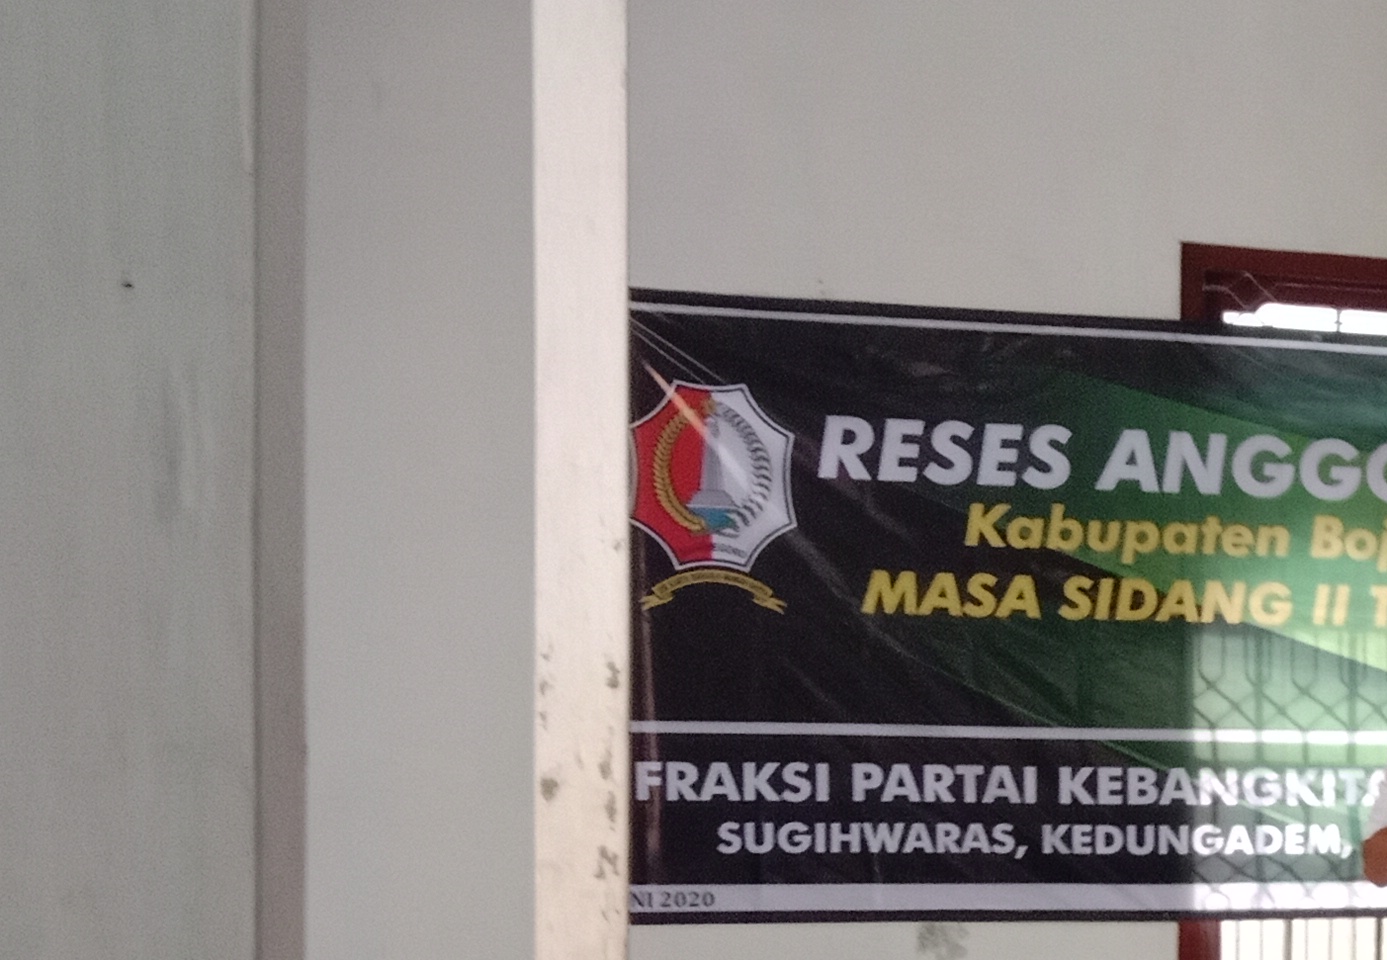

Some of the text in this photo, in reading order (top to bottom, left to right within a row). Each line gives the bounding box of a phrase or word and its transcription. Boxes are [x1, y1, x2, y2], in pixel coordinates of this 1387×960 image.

[817, 415, 1072, 488] RESES
[964, 503, 1289, 562] Kabupaten
[862, 571, 1040, 619] MASA
[1058, 576, 1292, 625] SIDANG
[1313, 584, 1350, 627] II
[636, 761, 1386, 807] FRAKSI PARTAI KEBANGKITA
[717, 822, 1353, 859] SUGIHWARAS, KEDUNGADEM,
[660, 891, 716, 908] 2020
